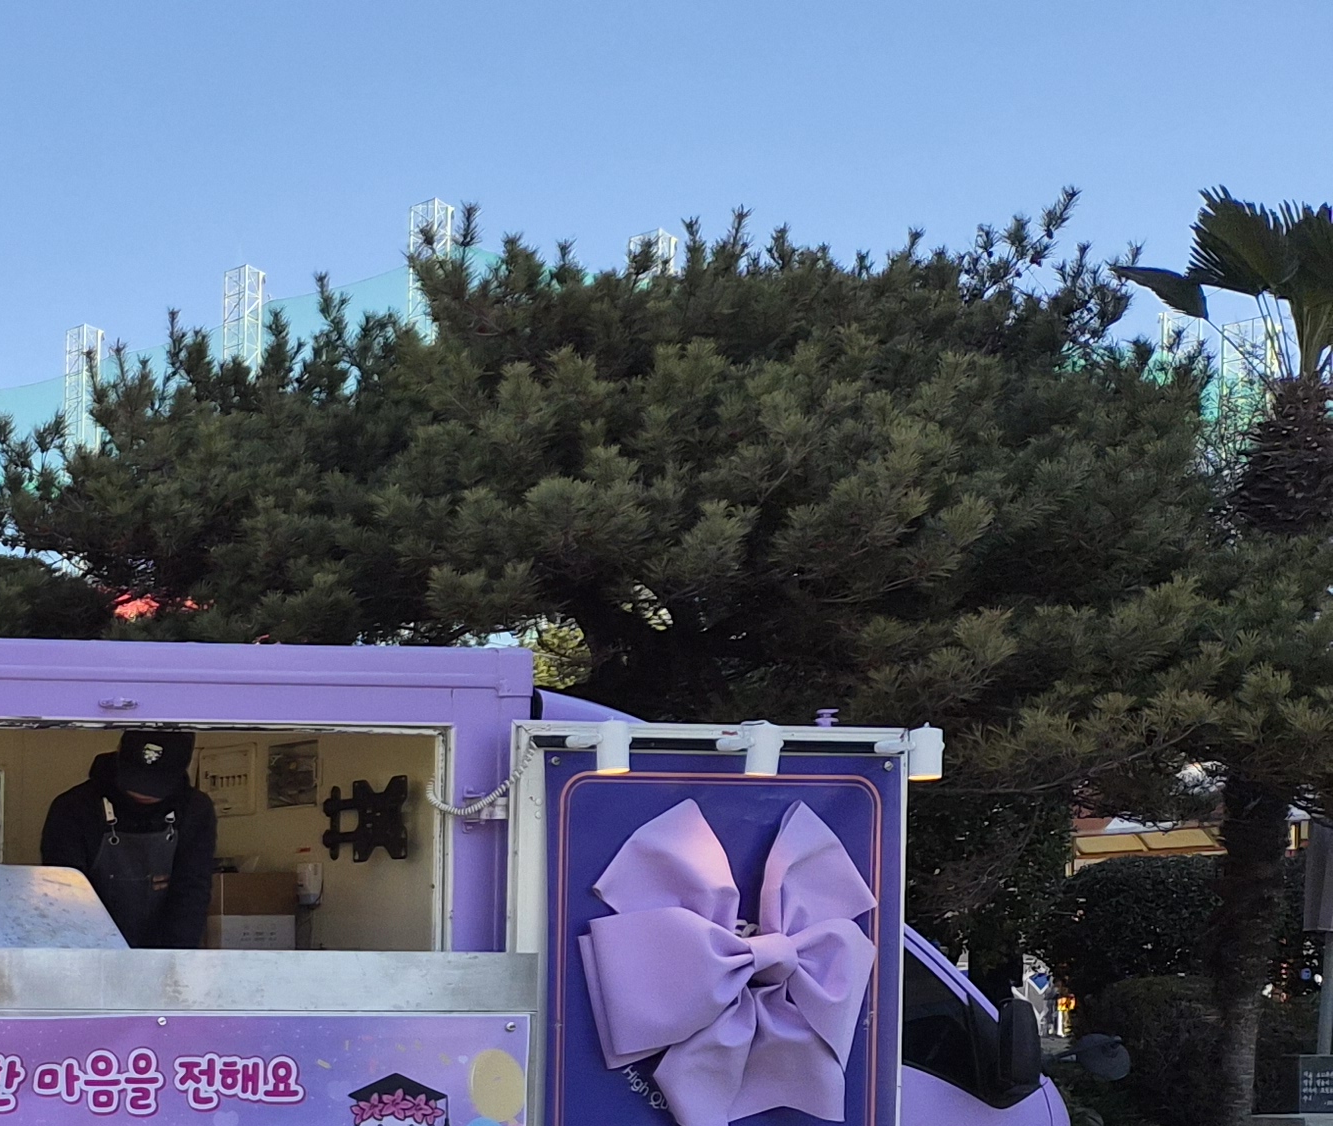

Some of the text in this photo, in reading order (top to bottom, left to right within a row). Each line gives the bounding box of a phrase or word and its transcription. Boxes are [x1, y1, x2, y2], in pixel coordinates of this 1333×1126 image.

[33, 1048, 164, 1115] 마음을
[174, 1053, 305, 1111] 전해요
[622, 1065, 649, 1096] High
